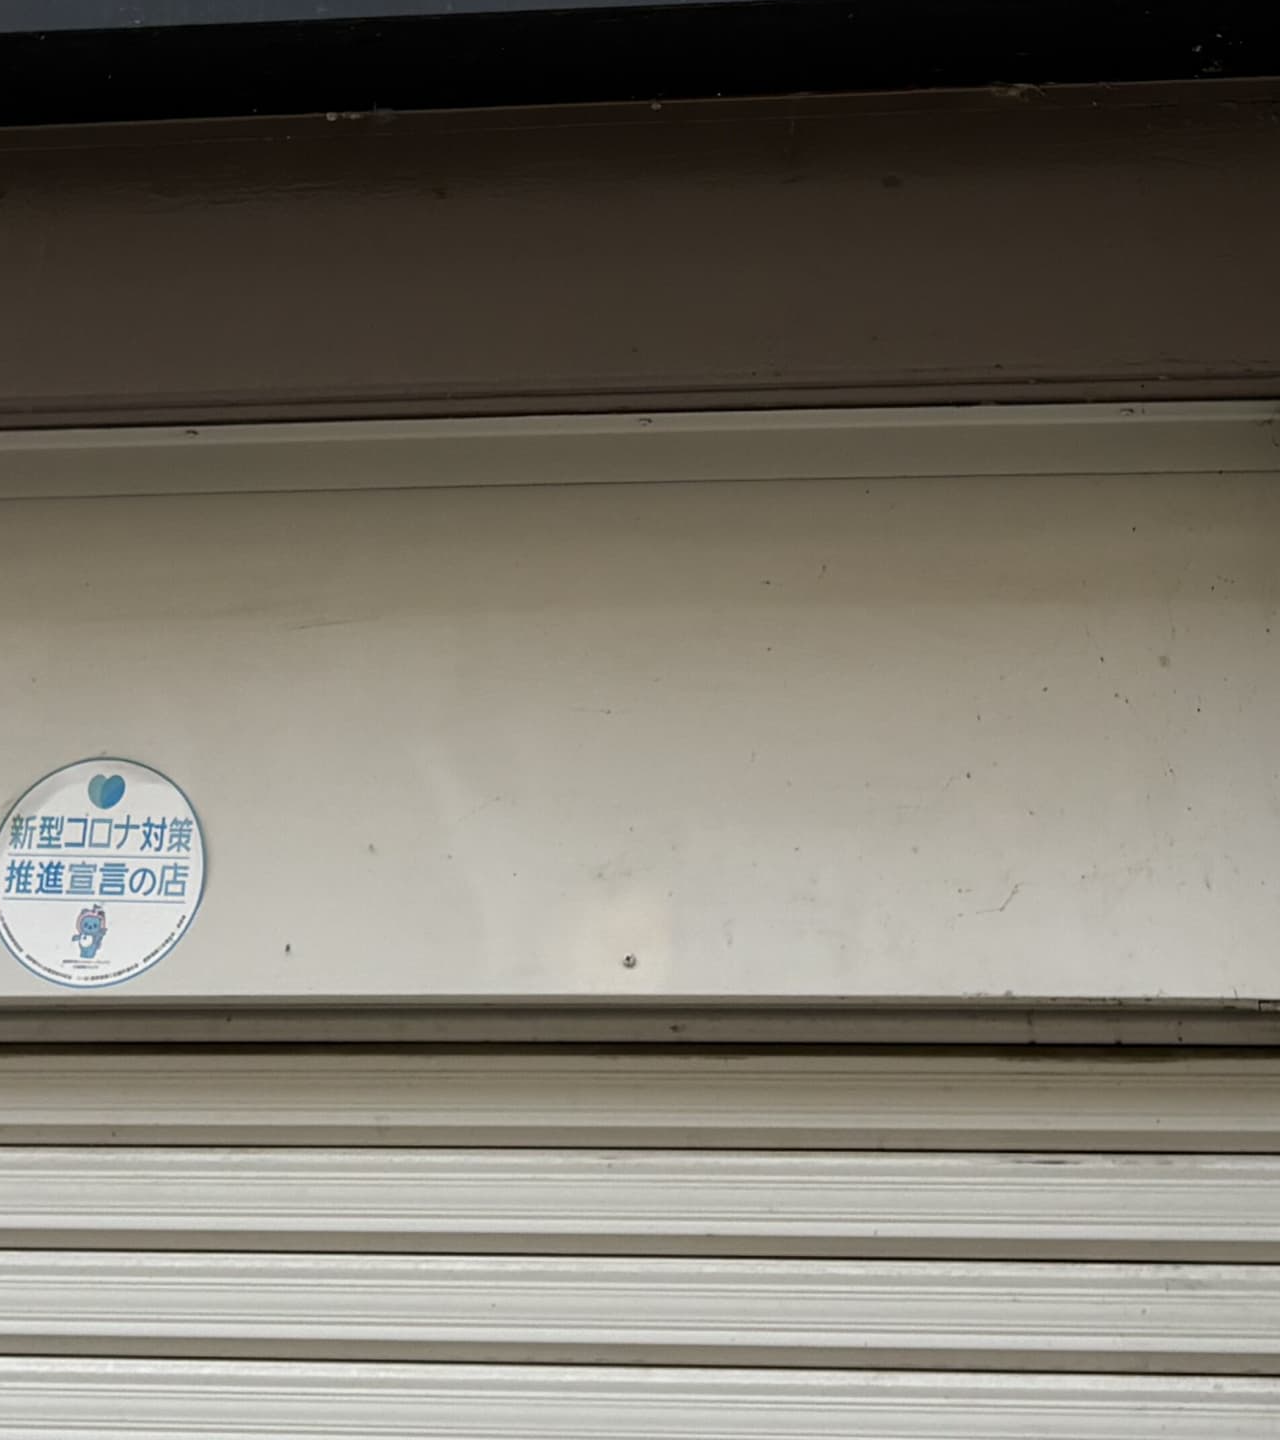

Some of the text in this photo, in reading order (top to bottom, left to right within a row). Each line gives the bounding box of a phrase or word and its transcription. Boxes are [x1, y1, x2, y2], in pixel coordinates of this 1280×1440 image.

[9, 814, 193, 853] 新型コロナ対策
[4, 858, 190, 897] 推進宣言の店
